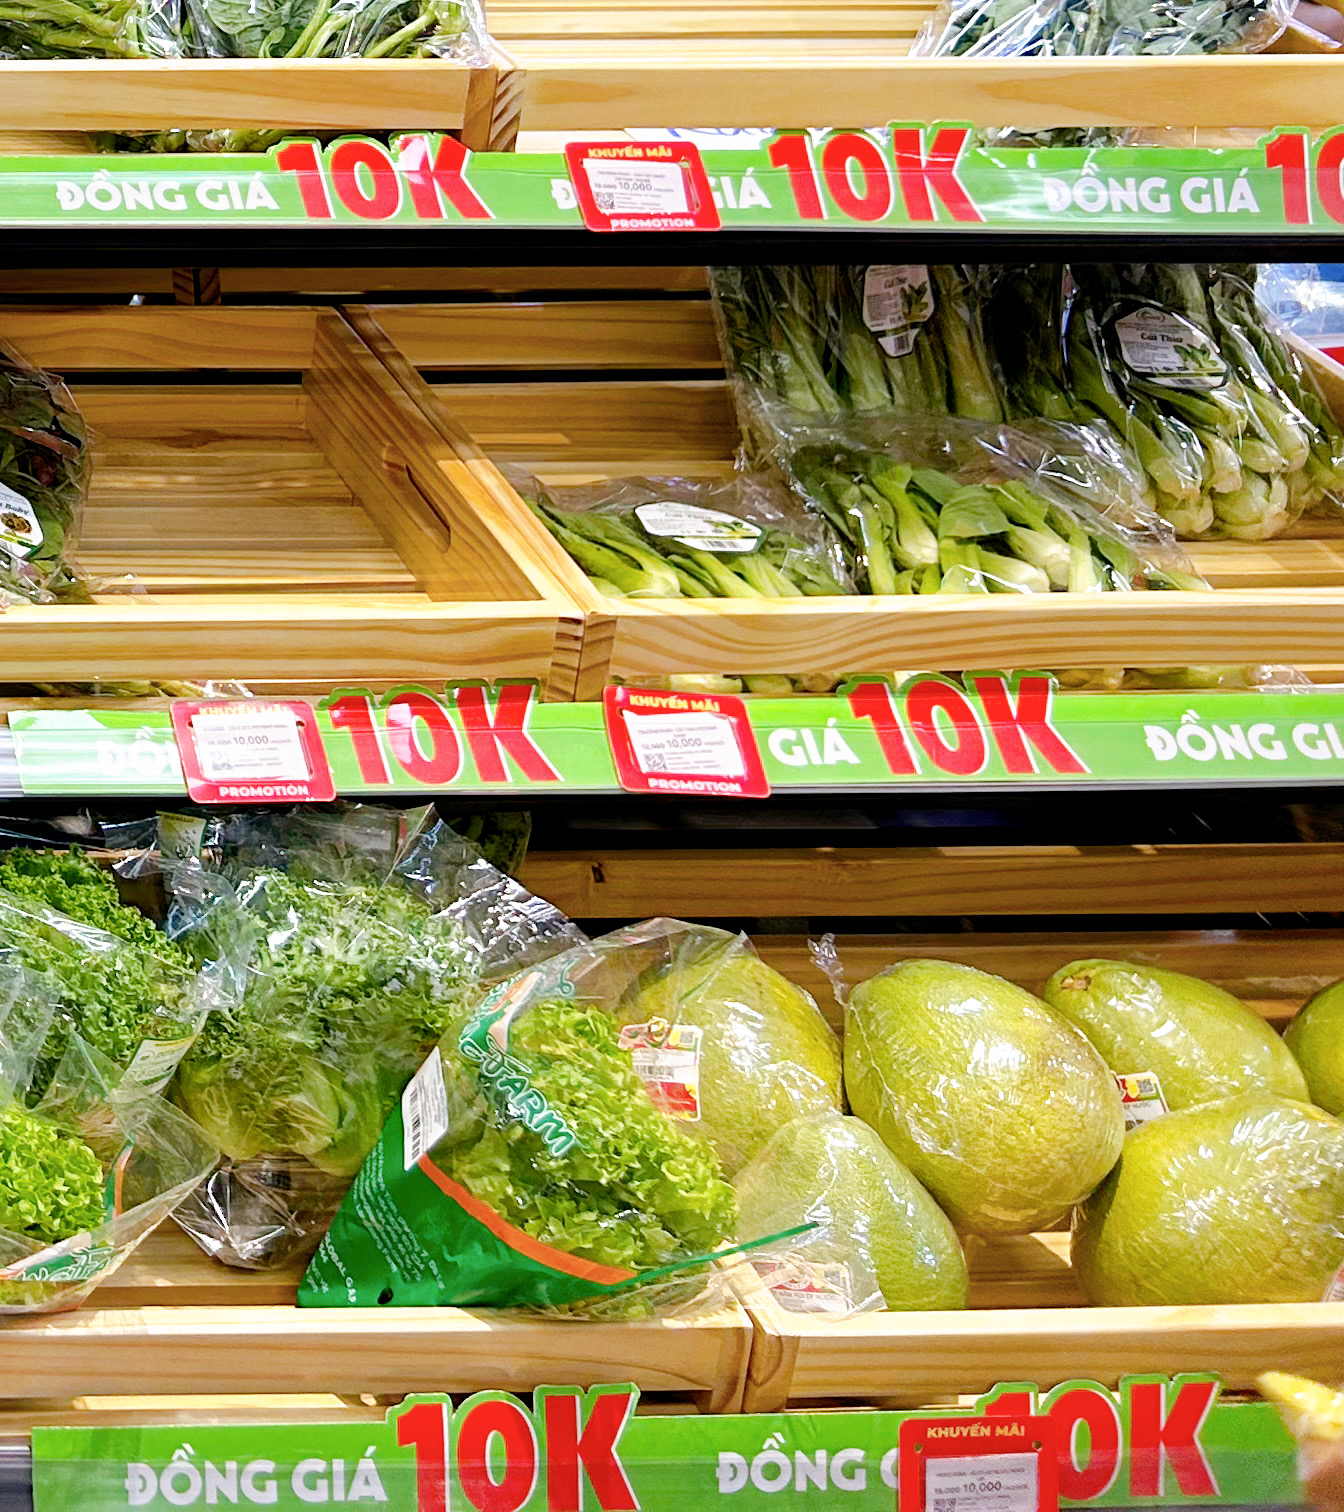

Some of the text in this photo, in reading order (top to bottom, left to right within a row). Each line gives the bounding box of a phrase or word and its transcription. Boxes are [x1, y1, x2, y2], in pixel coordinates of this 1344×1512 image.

[587, 144, 673, 158] KHUYẾN MÃI
[55, 134, 497, 220] ĐỒNG GIÁ 10K
[769, 126, 988, 222] 10K
[1042, 149, 1171, 214] ĐỒNG
[1180, 166, 1261, 214] GIÁ
[609, 217, 696, 230] PROMOTION
[629, 693, 720, 714] KHUYẾN MÃI
[331, 684, 566, 786] 10K
[767, 676, 1092, 775] GIÁ 10K
[1143, 709, 1344, 761] ĐỒNG GI
[232, 734, 269, 747] 10,000
[665, 737, 702, 750] 10,000
[218, 784, 310, 798] PROMOTION
[647, 777, 743, 794] PROMOTION
[717, 1380, 1223, 1500] ĐỒNG 0K
[926, 1423, 1025, 1440] KHUYẾN MÃI
[125, 1386, 640, 1512] ĐỒNG GIÁ 10K
[962, 1480, 1002, 1494] 10,000
